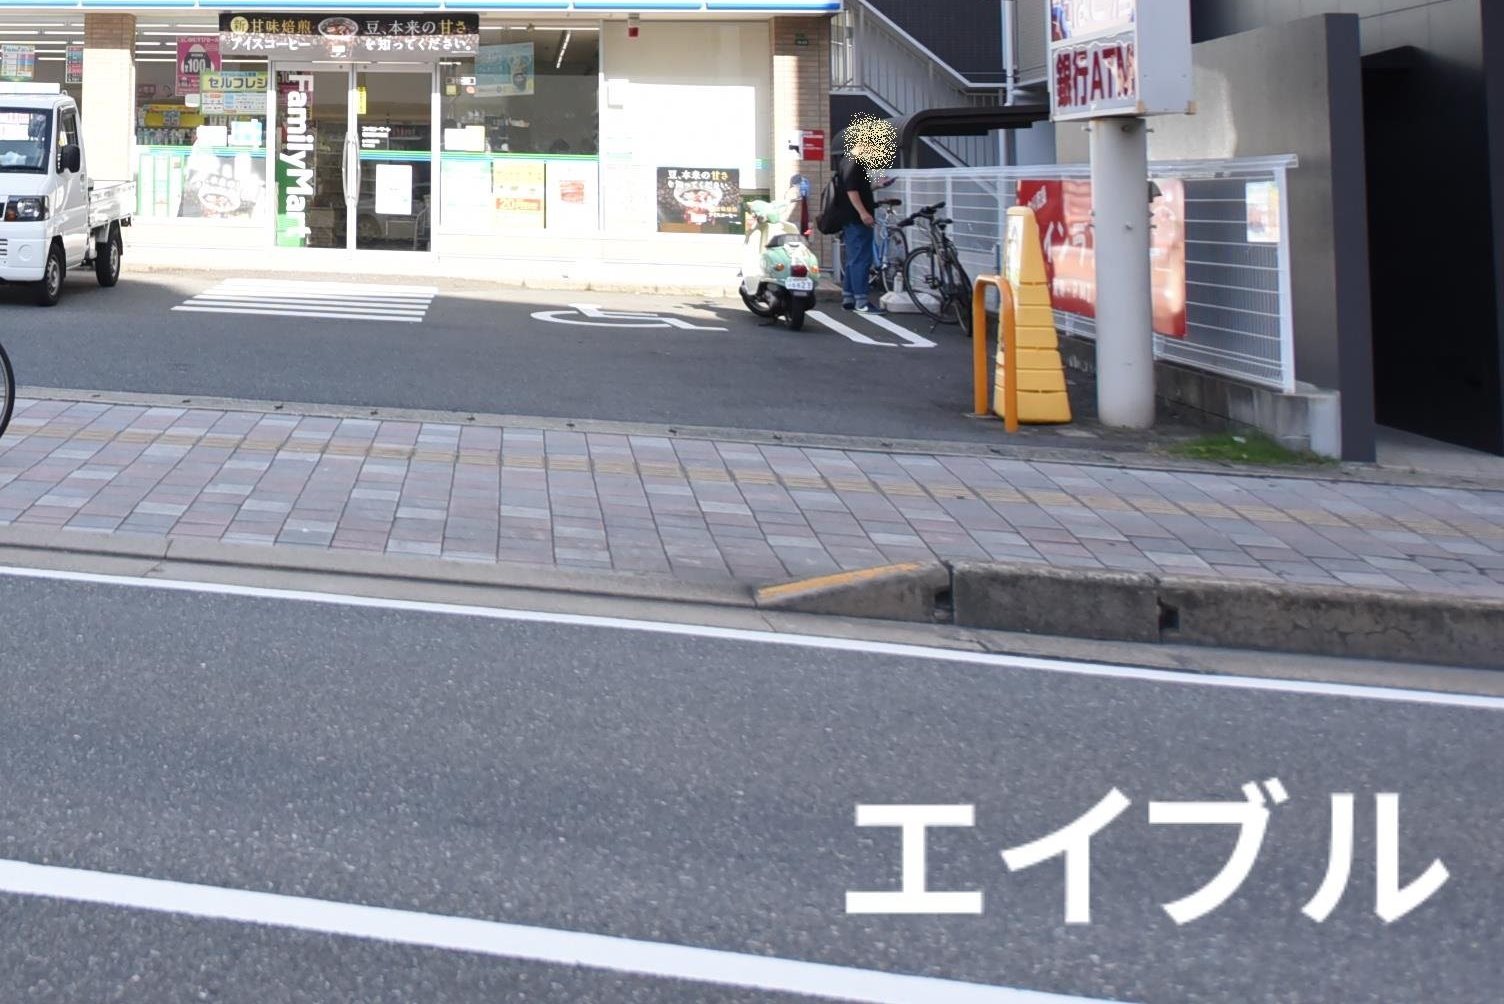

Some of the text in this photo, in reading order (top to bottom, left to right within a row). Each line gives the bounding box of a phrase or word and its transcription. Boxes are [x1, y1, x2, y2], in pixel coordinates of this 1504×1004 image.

[365, 19, 468, 35] 豆、本来の甘さ
[231, 37, 311, 51] アイスコーヒー
[365, 37, 472, 51] を知ってください。
[280, 74, 315, 245] FamilyMart
